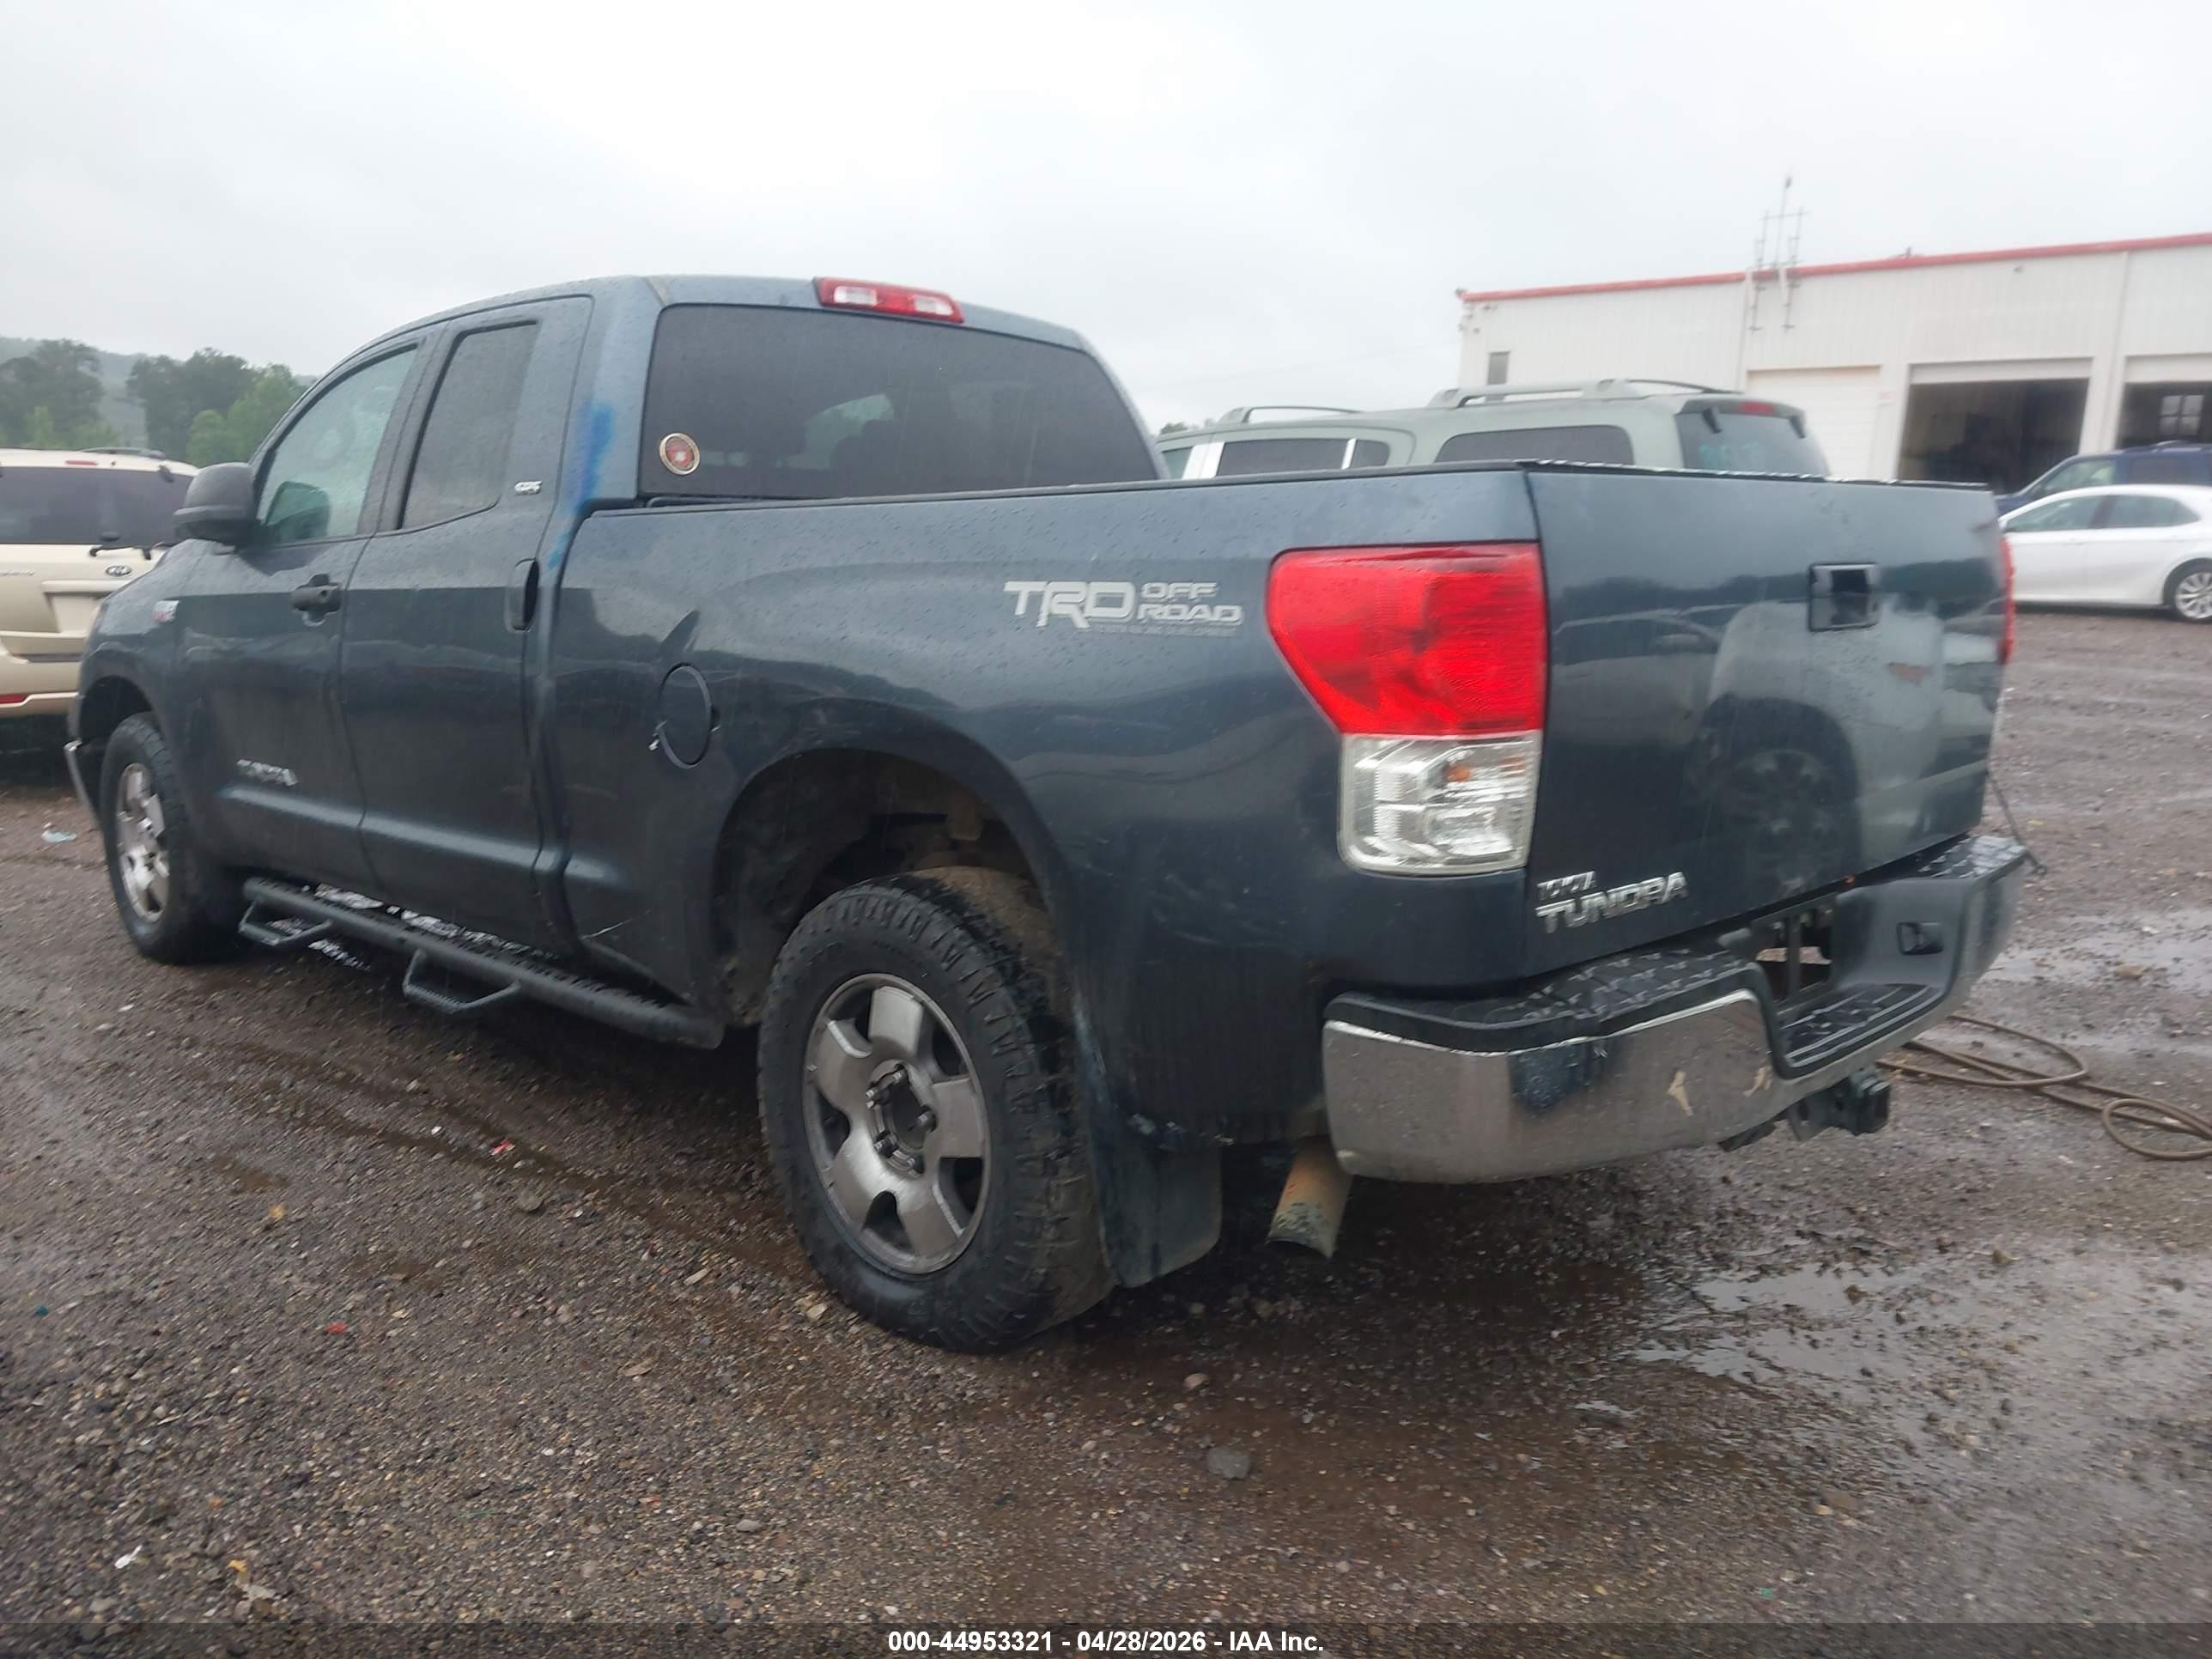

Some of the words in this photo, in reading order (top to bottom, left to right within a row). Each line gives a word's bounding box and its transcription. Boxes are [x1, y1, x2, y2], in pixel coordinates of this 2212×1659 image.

[1003, 580, 1136, 629] TRD
[1140, 581, 1218, 602] OFF
[1137, 603, 1243, 625] ROAD
[1535, 872, 1689, 933] TUNDRA
